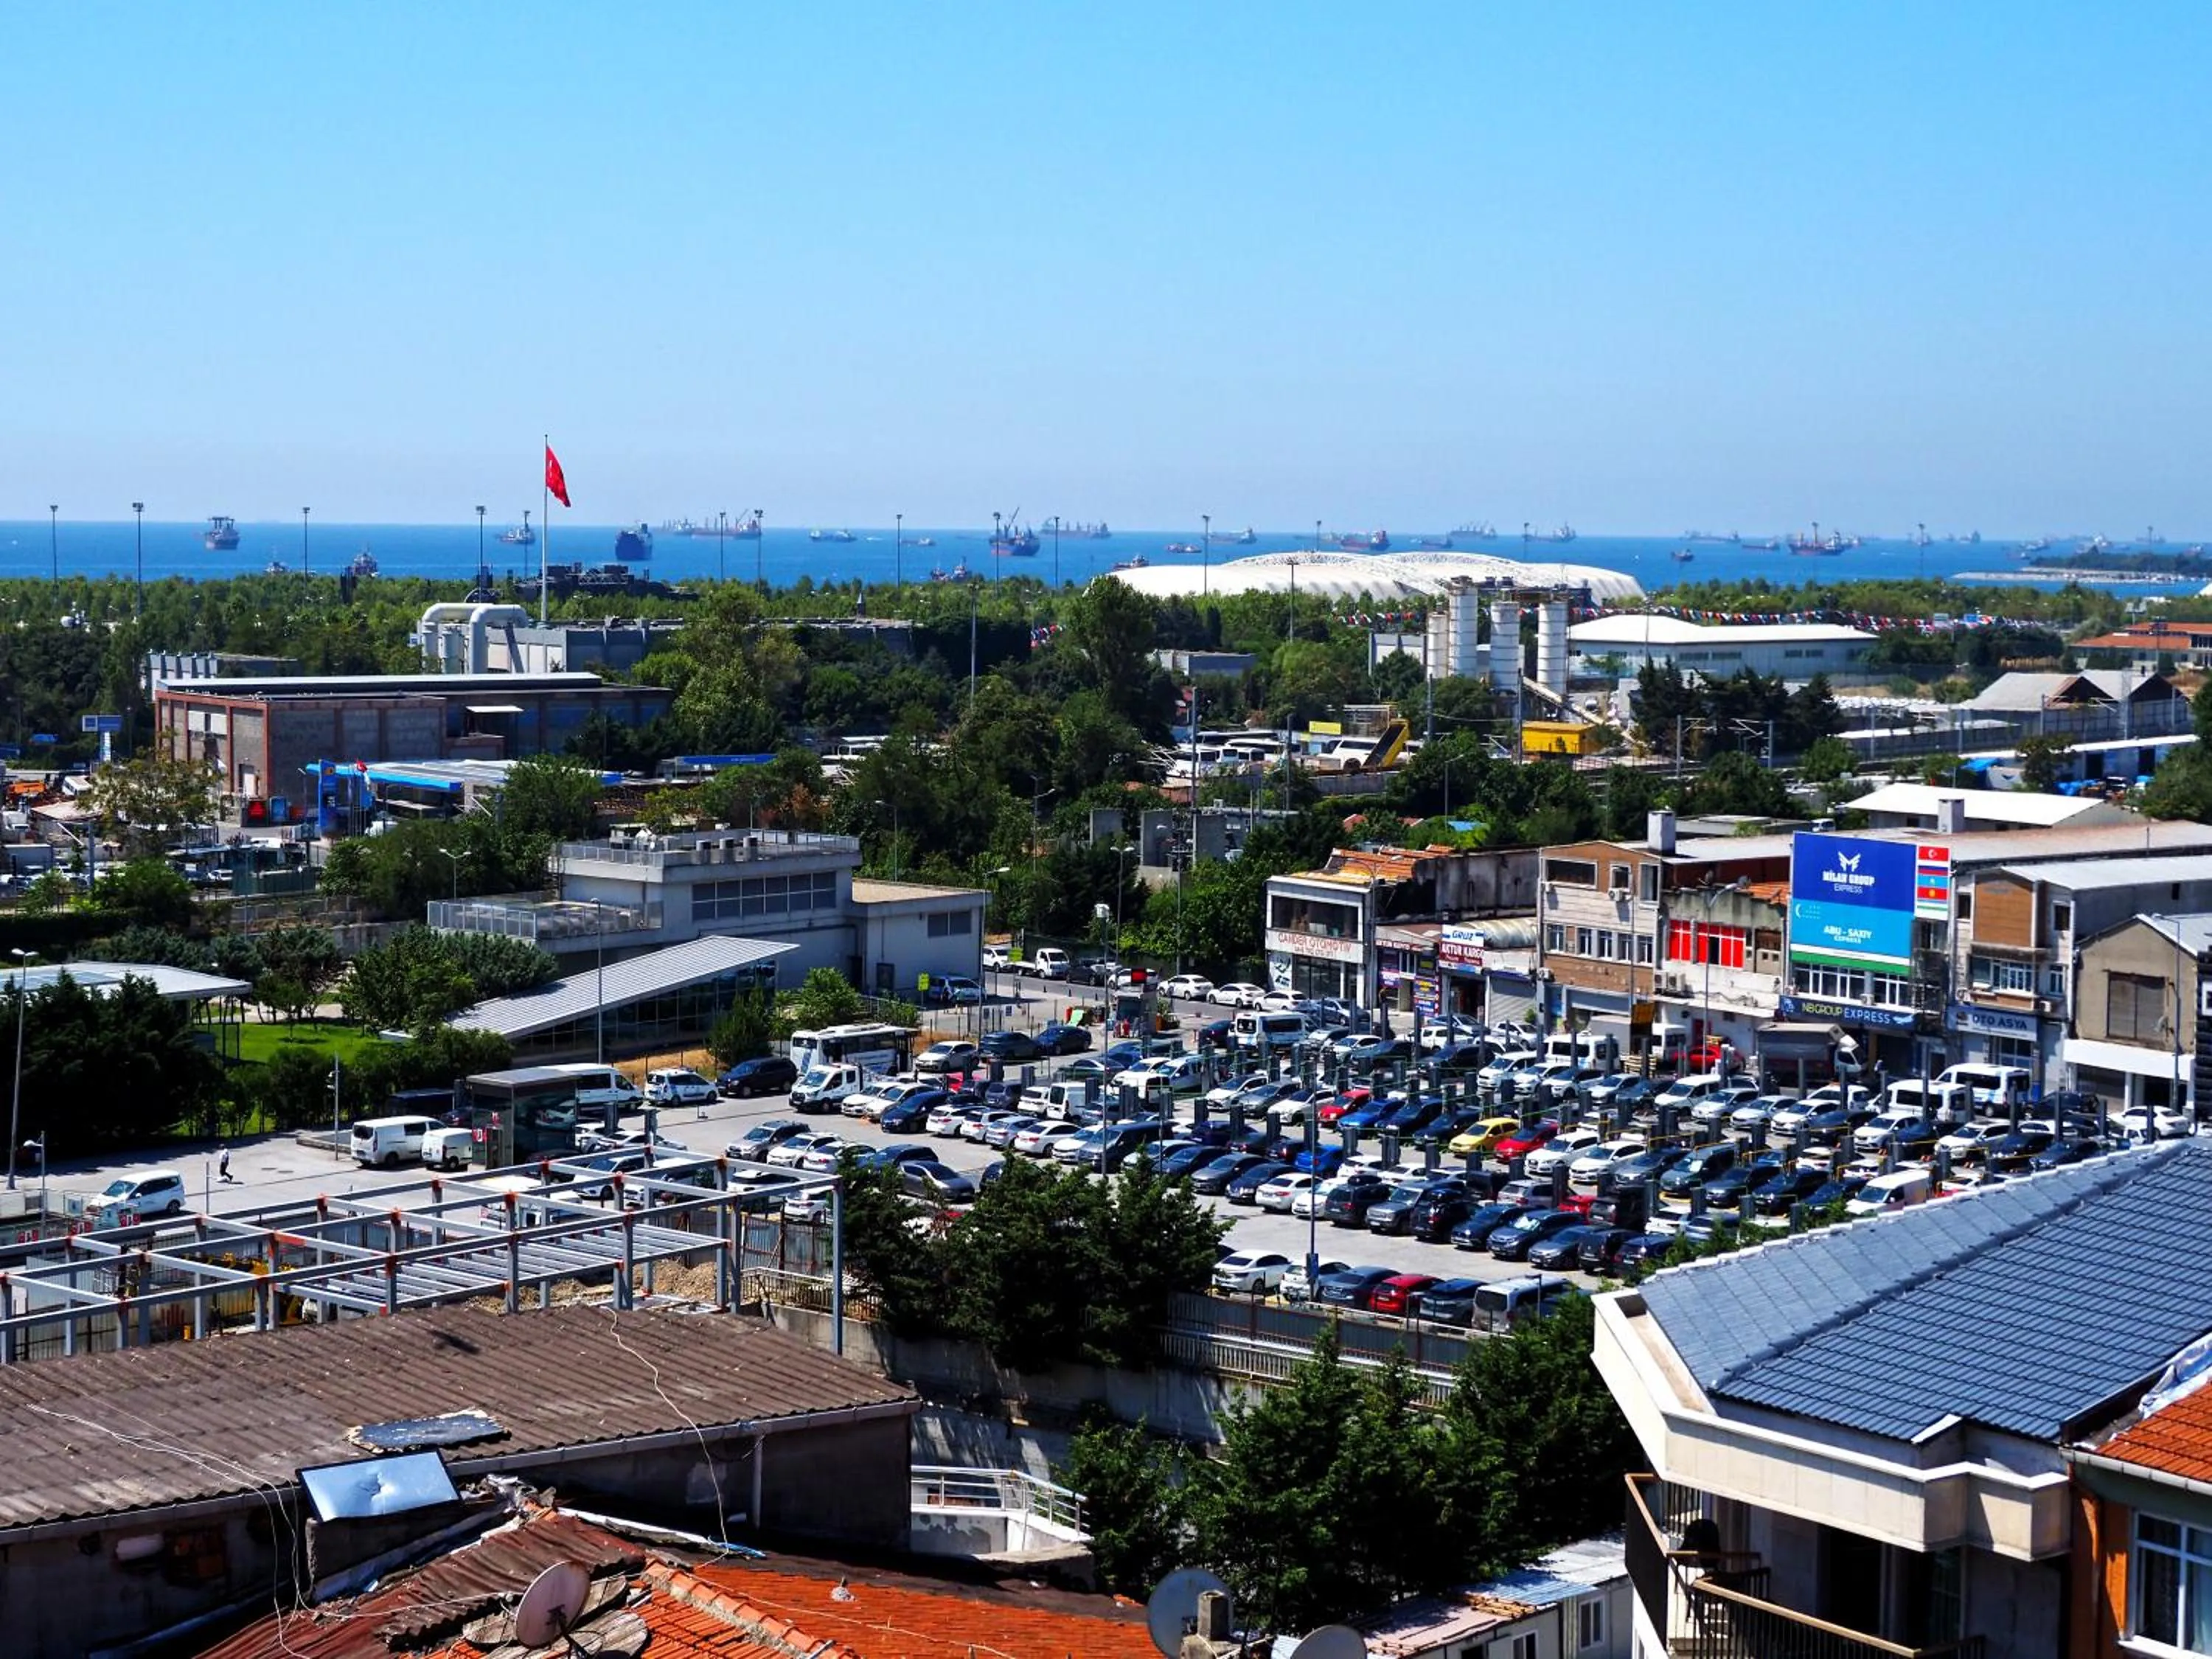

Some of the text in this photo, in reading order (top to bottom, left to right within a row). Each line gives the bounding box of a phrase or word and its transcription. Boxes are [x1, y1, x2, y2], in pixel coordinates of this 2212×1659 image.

[1848, 874, 1875, 886] GROUP
[1834, 883, 1863, 894] EXPRESS
[1844, 1008, 1891, 1024] EXPRESS
[1972, 1015, 2028, 1030] OTO ASYA
